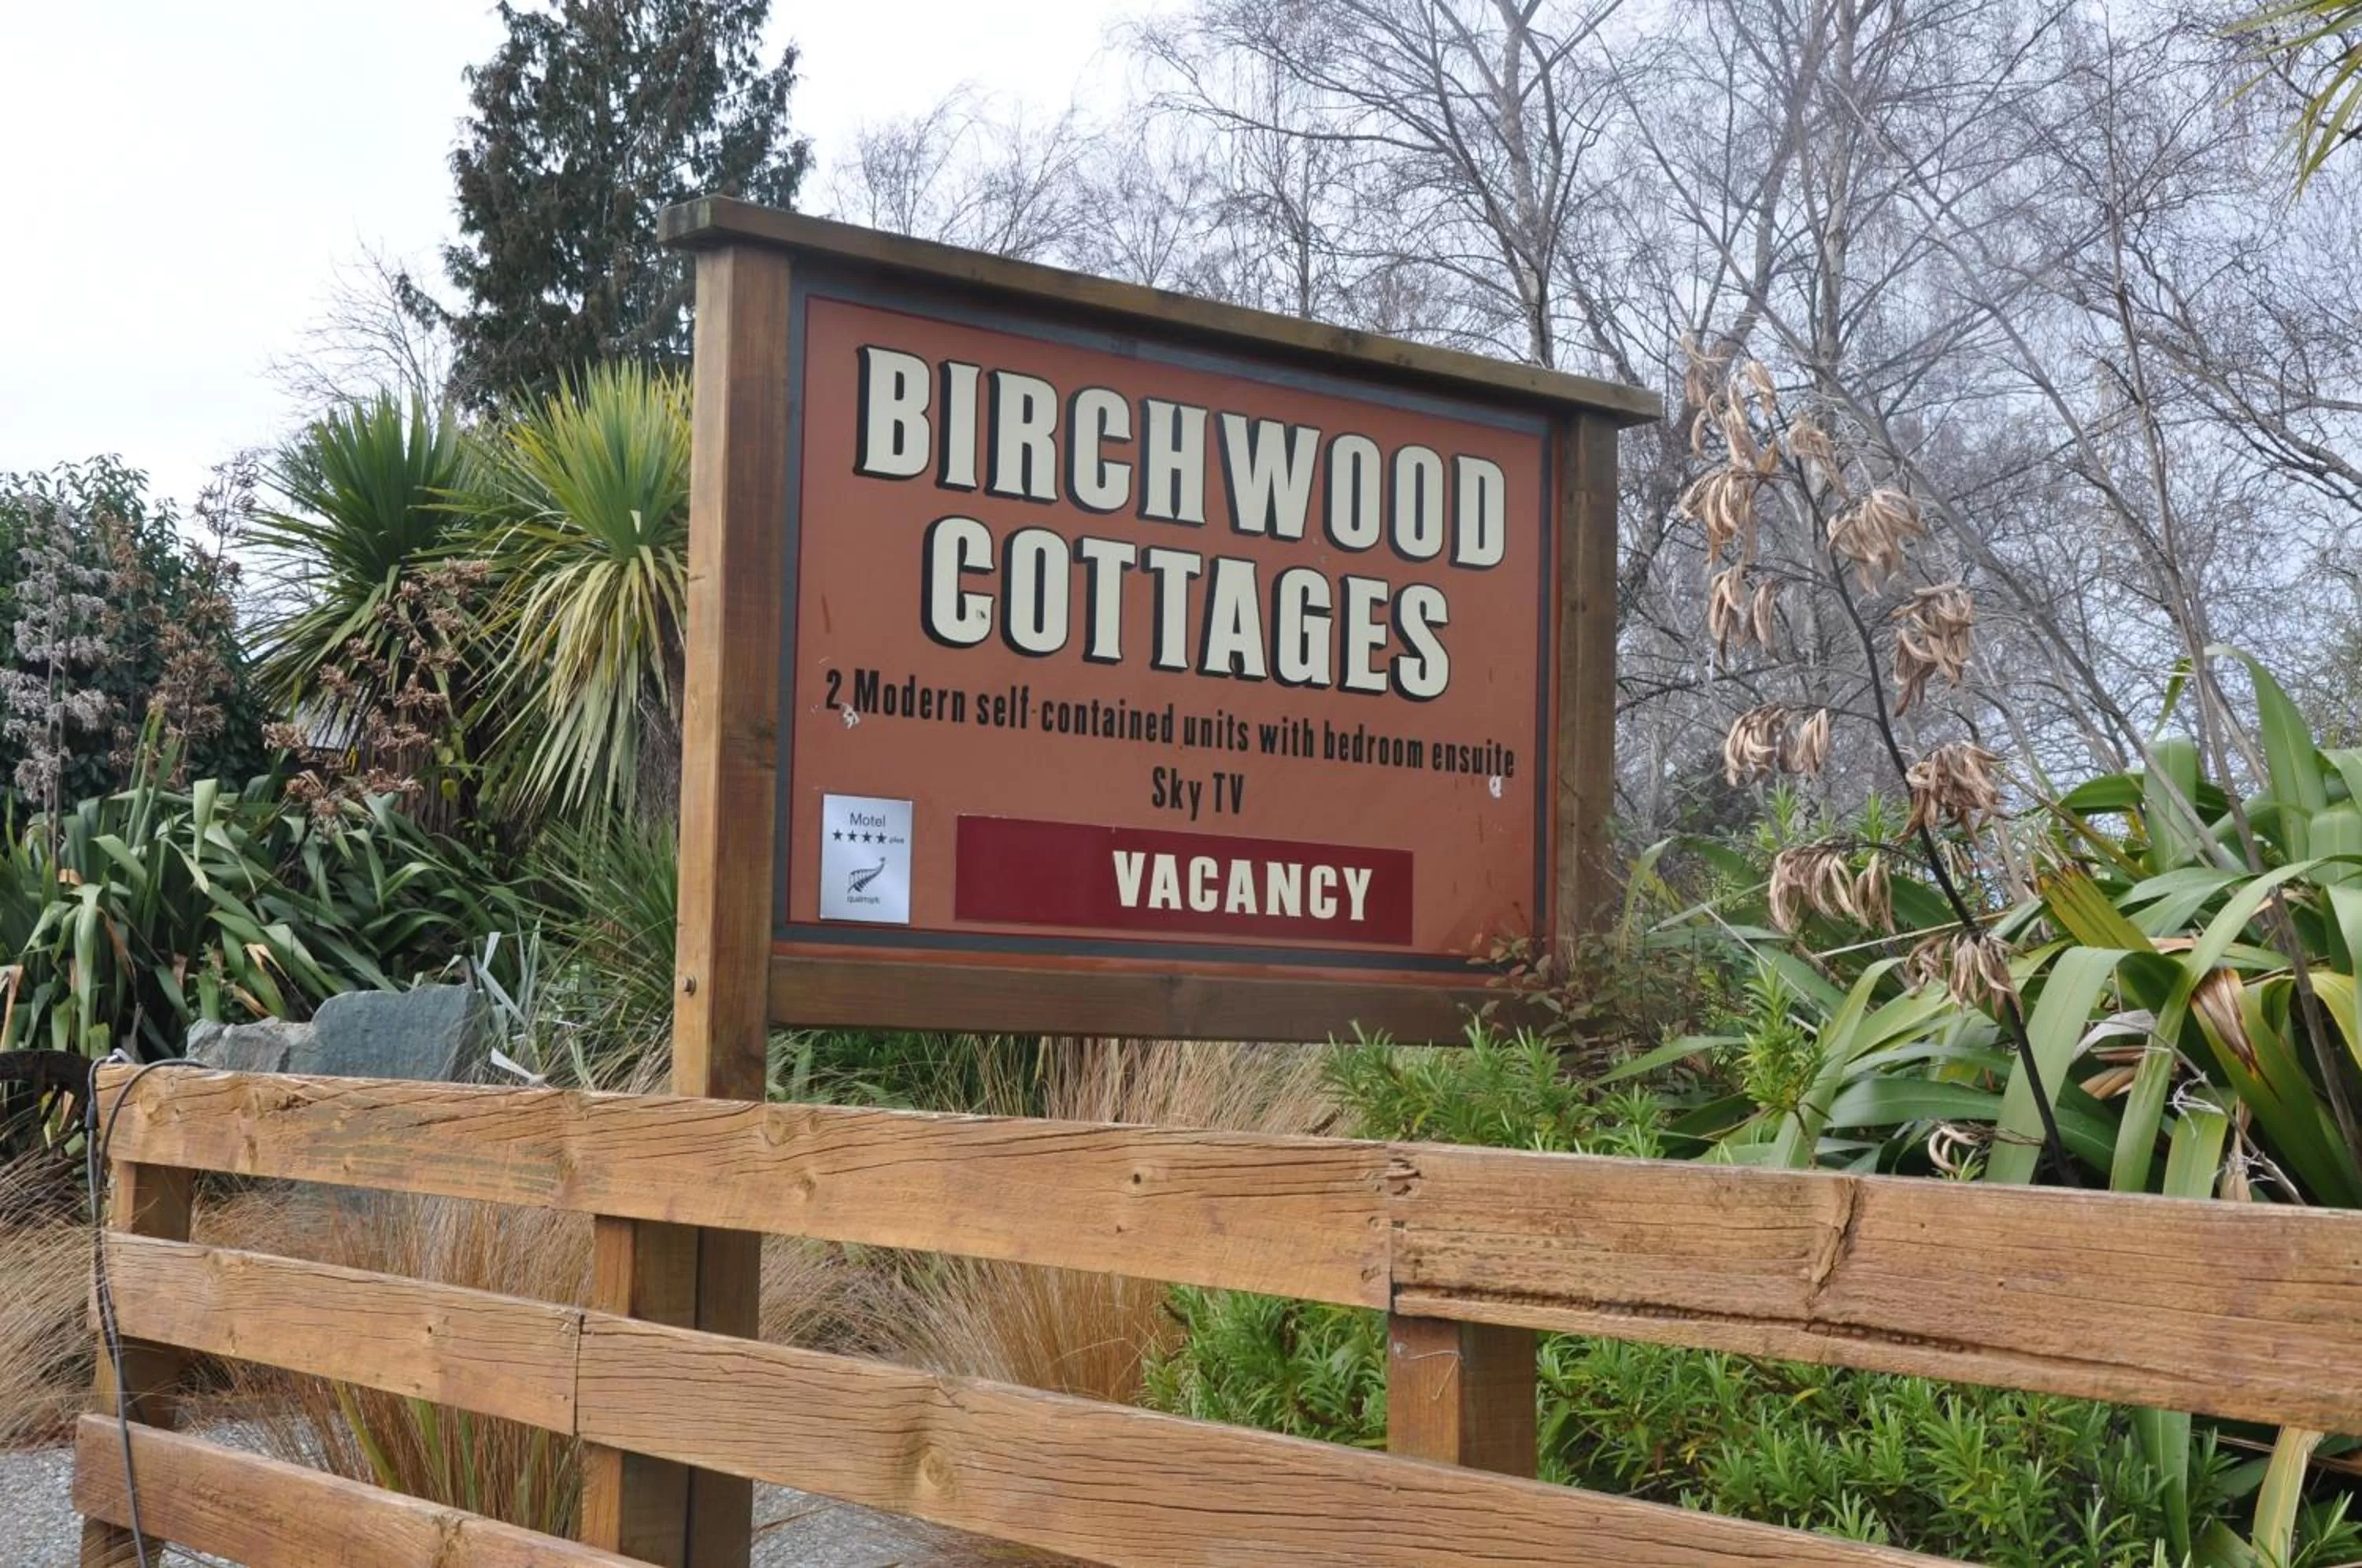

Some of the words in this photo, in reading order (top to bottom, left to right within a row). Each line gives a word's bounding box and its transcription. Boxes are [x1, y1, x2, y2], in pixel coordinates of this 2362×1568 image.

[853, 345, 1507, 570] BIRCHWOOD
[923, 516, 1451, 701] COTTAGES
[826, 668, 842, 709] 2
[854, 668, 966, 723] Modern
[976, 686, 1029, 729] self
[1042, 699, 1174, 744] contained
[1183, 708, 1249, 752] units
[1259, 716, 1314, 758] with
[1324, 719, 1423, 769] bedroom
[1431, 738, 1515, 778] ensuite
[850, 812, 886, 827] Motel
[1151, 766, 1202, 822] Sky
[1212, 772, 1244, 815] TV
[1112, 850, 1373, 922] VACANCY
